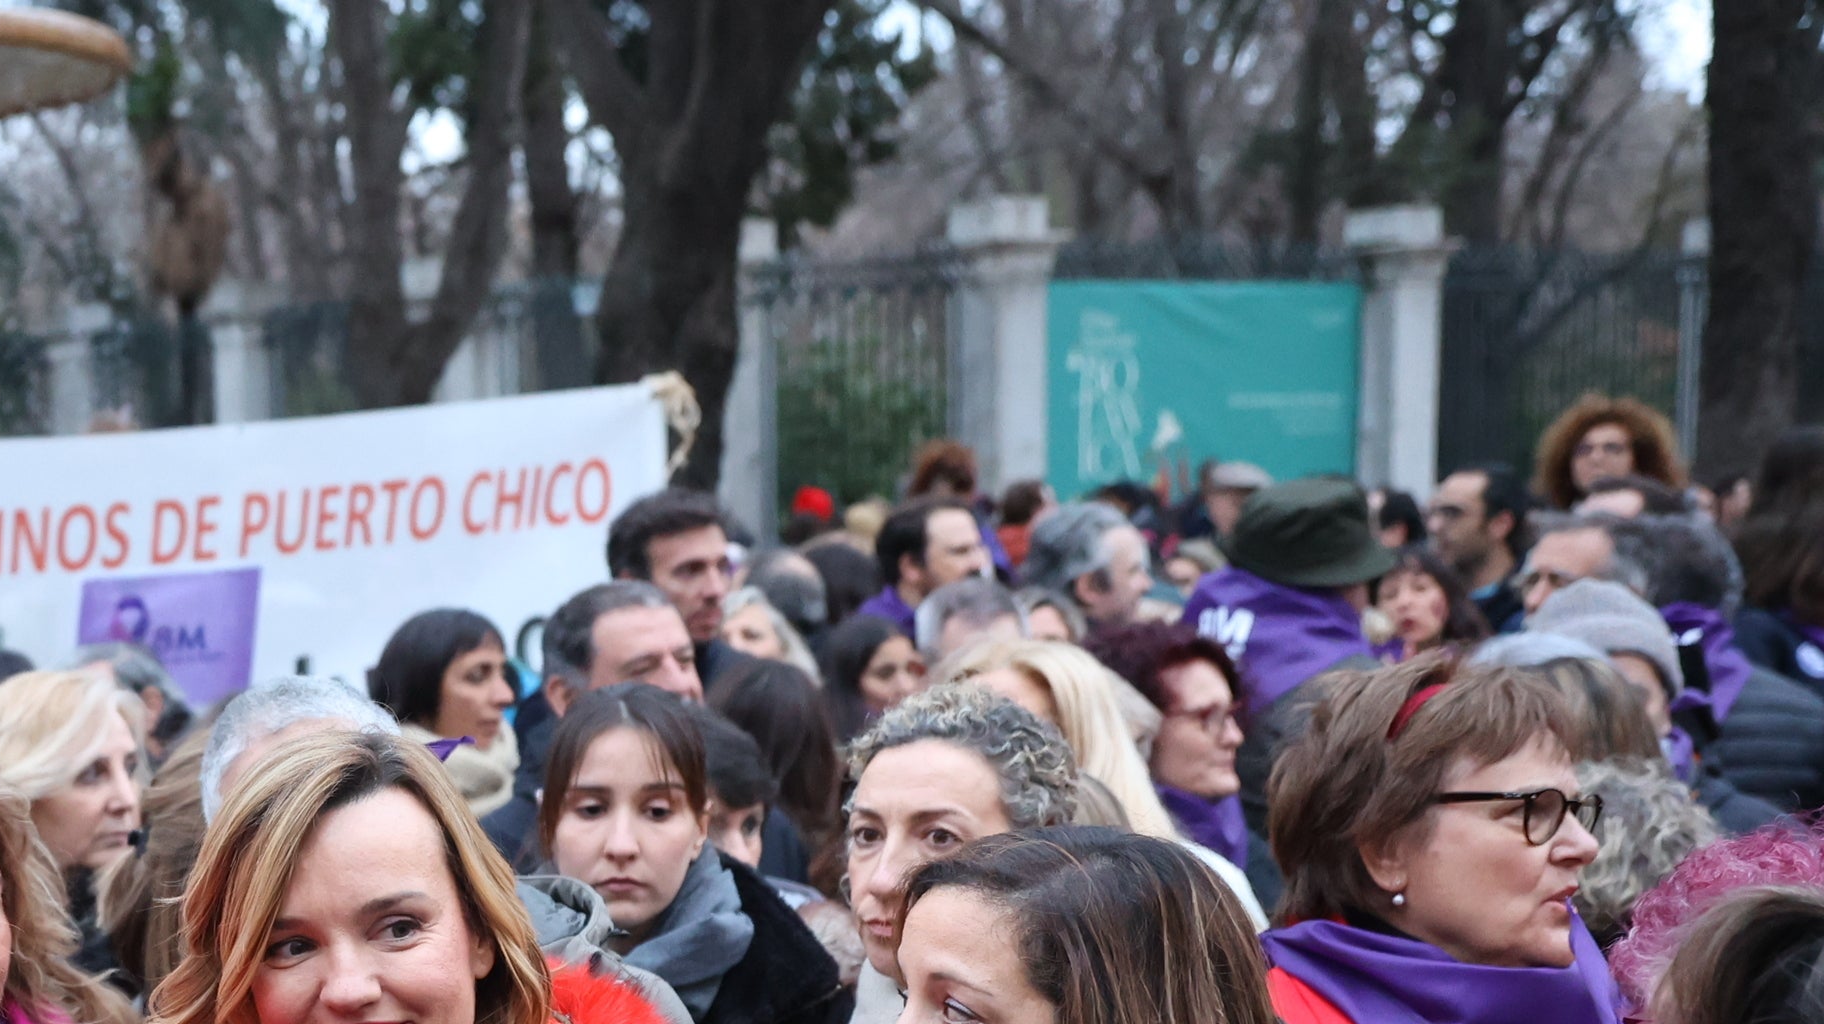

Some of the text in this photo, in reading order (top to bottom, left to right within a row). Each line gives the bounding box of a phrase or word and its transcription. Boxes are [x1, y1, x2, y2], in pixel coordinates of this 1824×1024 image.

[150, 497, 220, 565] DE
[239, 474, 446, 557] PUERTO
[462, 456, 613, 536] CHICO
